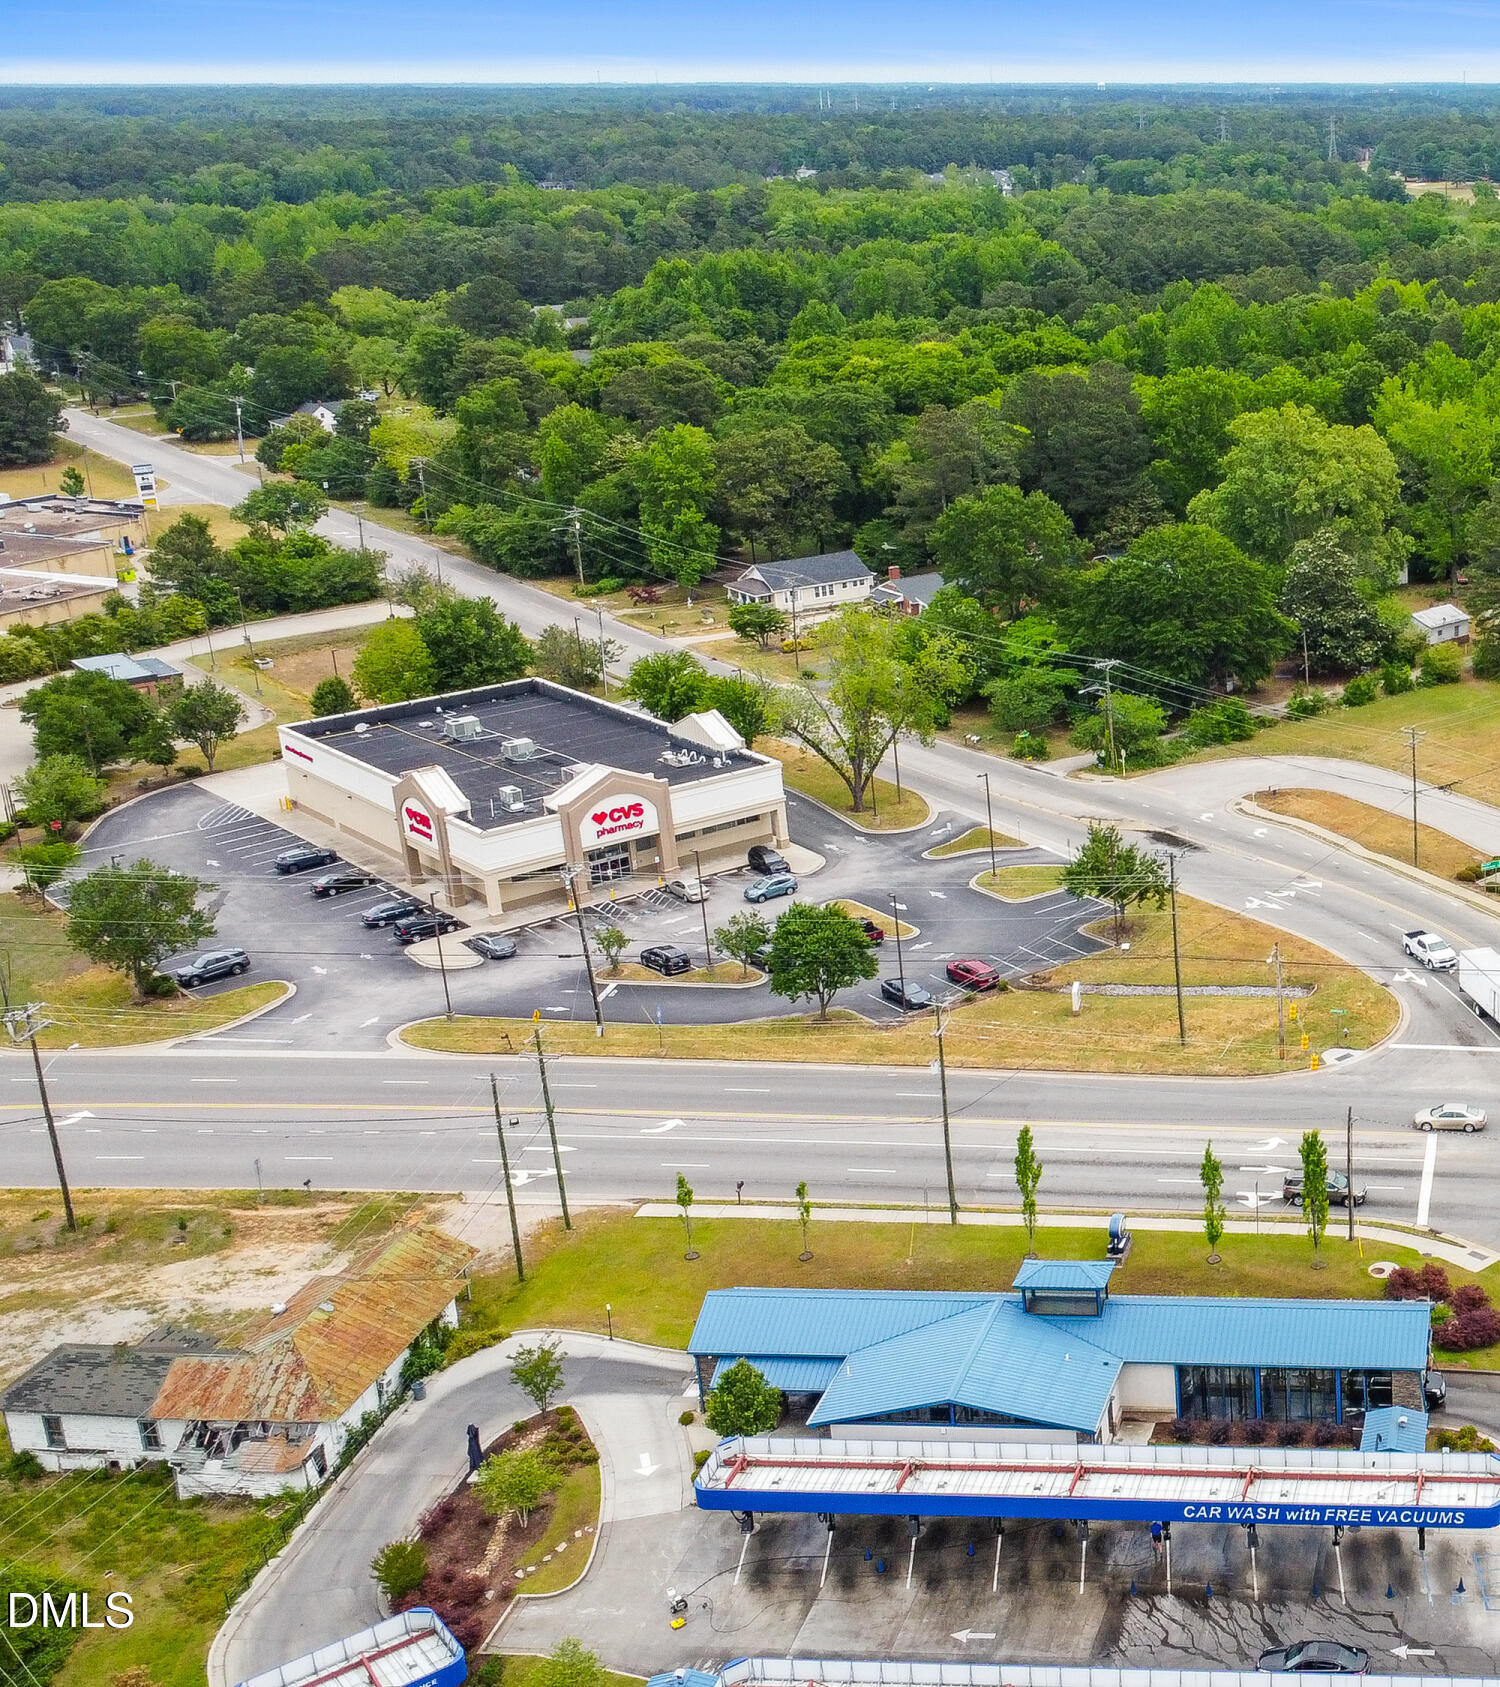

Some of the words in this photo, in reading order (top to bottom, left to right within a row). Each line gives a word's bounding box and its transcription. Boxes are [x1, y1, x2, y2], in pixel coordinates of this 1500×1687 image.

[609, 803, 644, 822] CVS
[597, 820, 644, 839] pharmacy
[1183, 1505, 1222, 1519] CAR
[1228, 1506, 1280, 1520] WASH
[1286, 1507, 1321, 1521] with
[1324, 1508, 1372, 1522] FREE
[1377, 1510, 1465, 1524] VACUUMS
